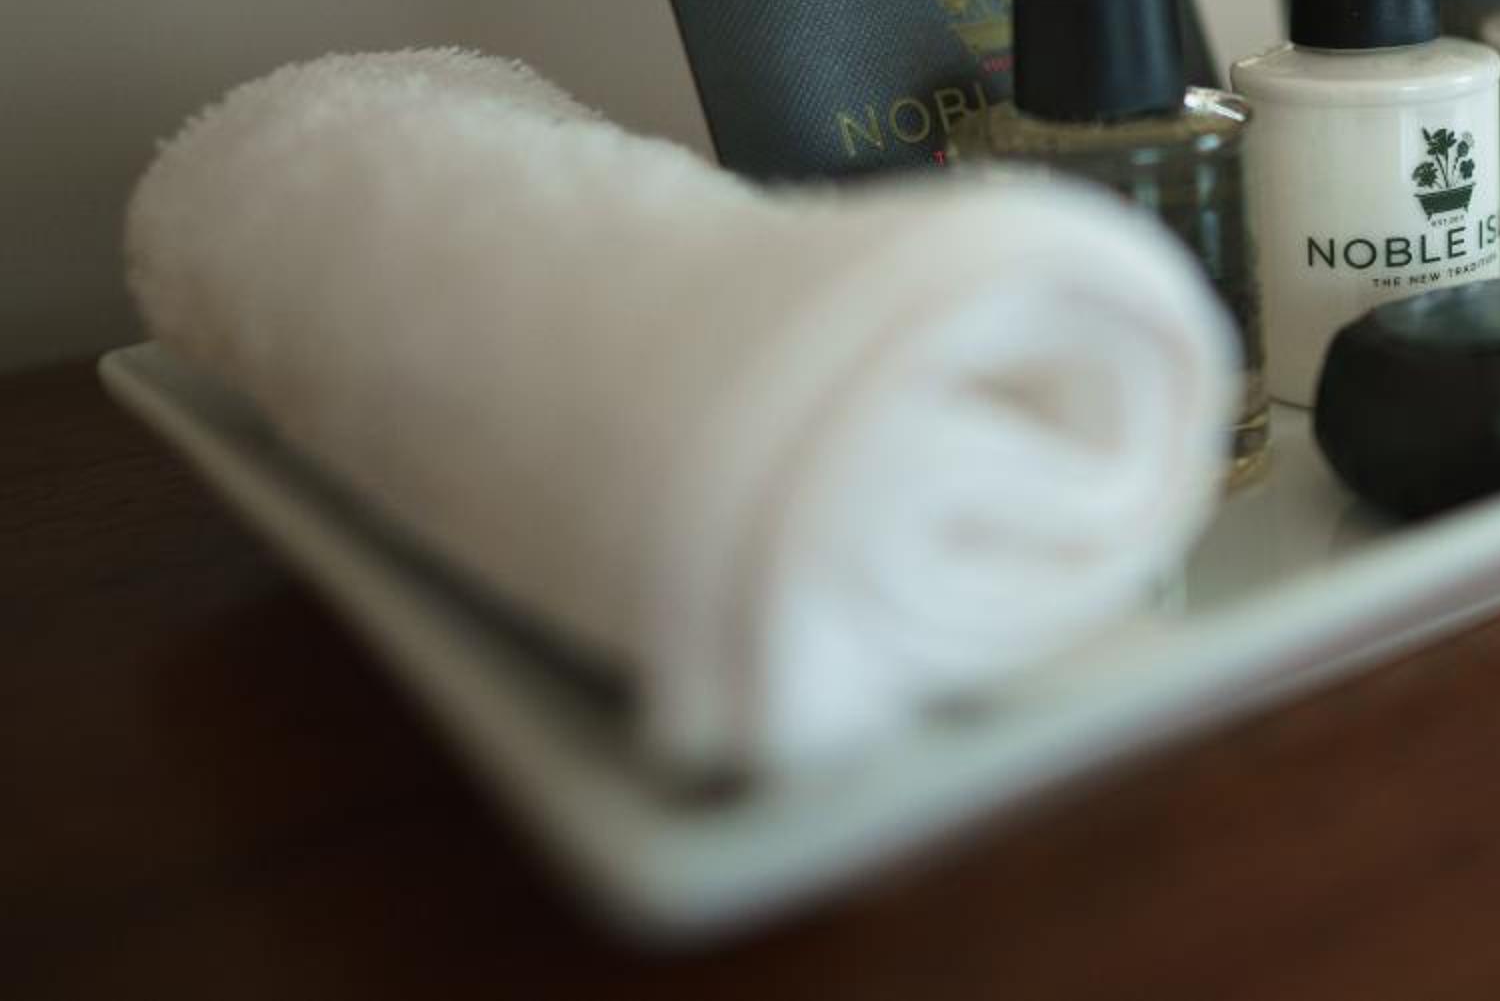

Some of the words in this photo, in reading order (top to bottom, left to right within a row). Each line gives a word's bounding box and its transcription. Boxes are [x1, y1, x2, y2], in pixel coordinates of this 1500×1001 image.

[1306, 225, 1467, 270] NOBLE
[1372, 276, 1401, 288] THE
[1409, 272, 1441, 286] NEW
